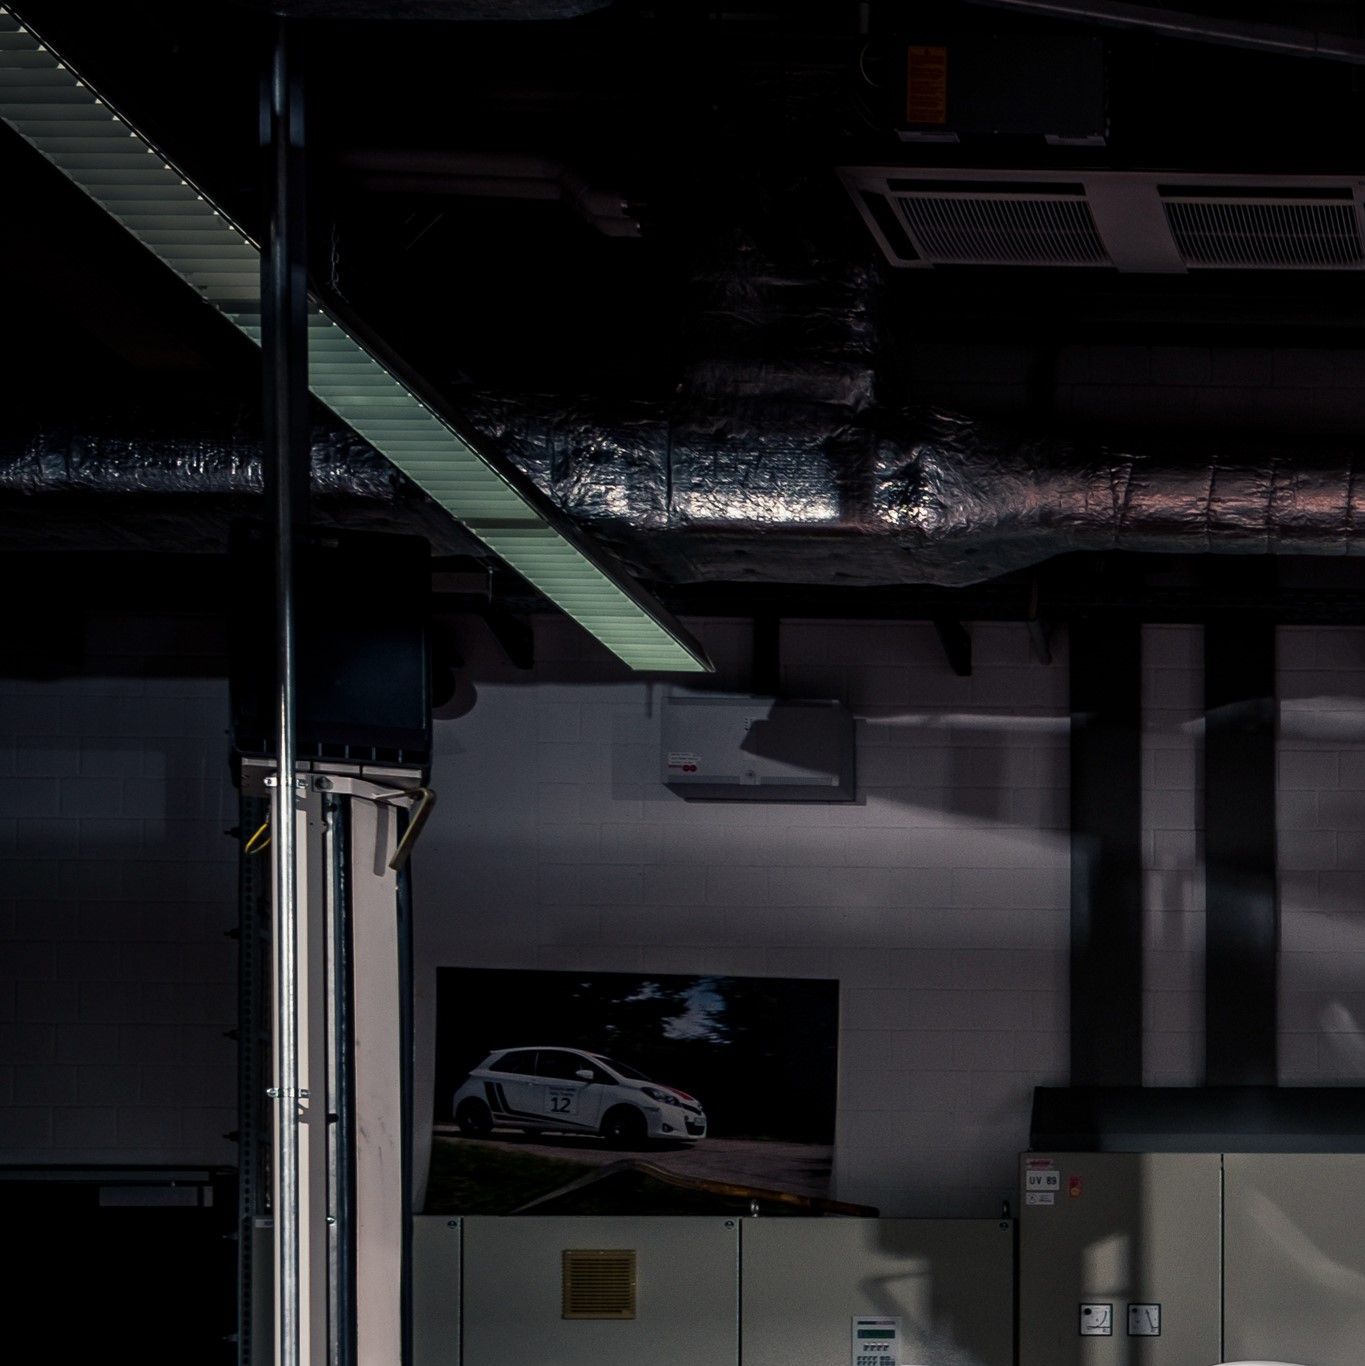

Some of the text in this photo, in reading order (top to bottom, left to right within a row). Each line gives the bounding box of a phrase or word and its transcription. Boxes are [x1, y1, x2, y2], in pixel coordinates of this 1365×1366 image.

[551, 1097, 571, 1113] 12
[1029, 1176, 1057, 1185] UV 89
